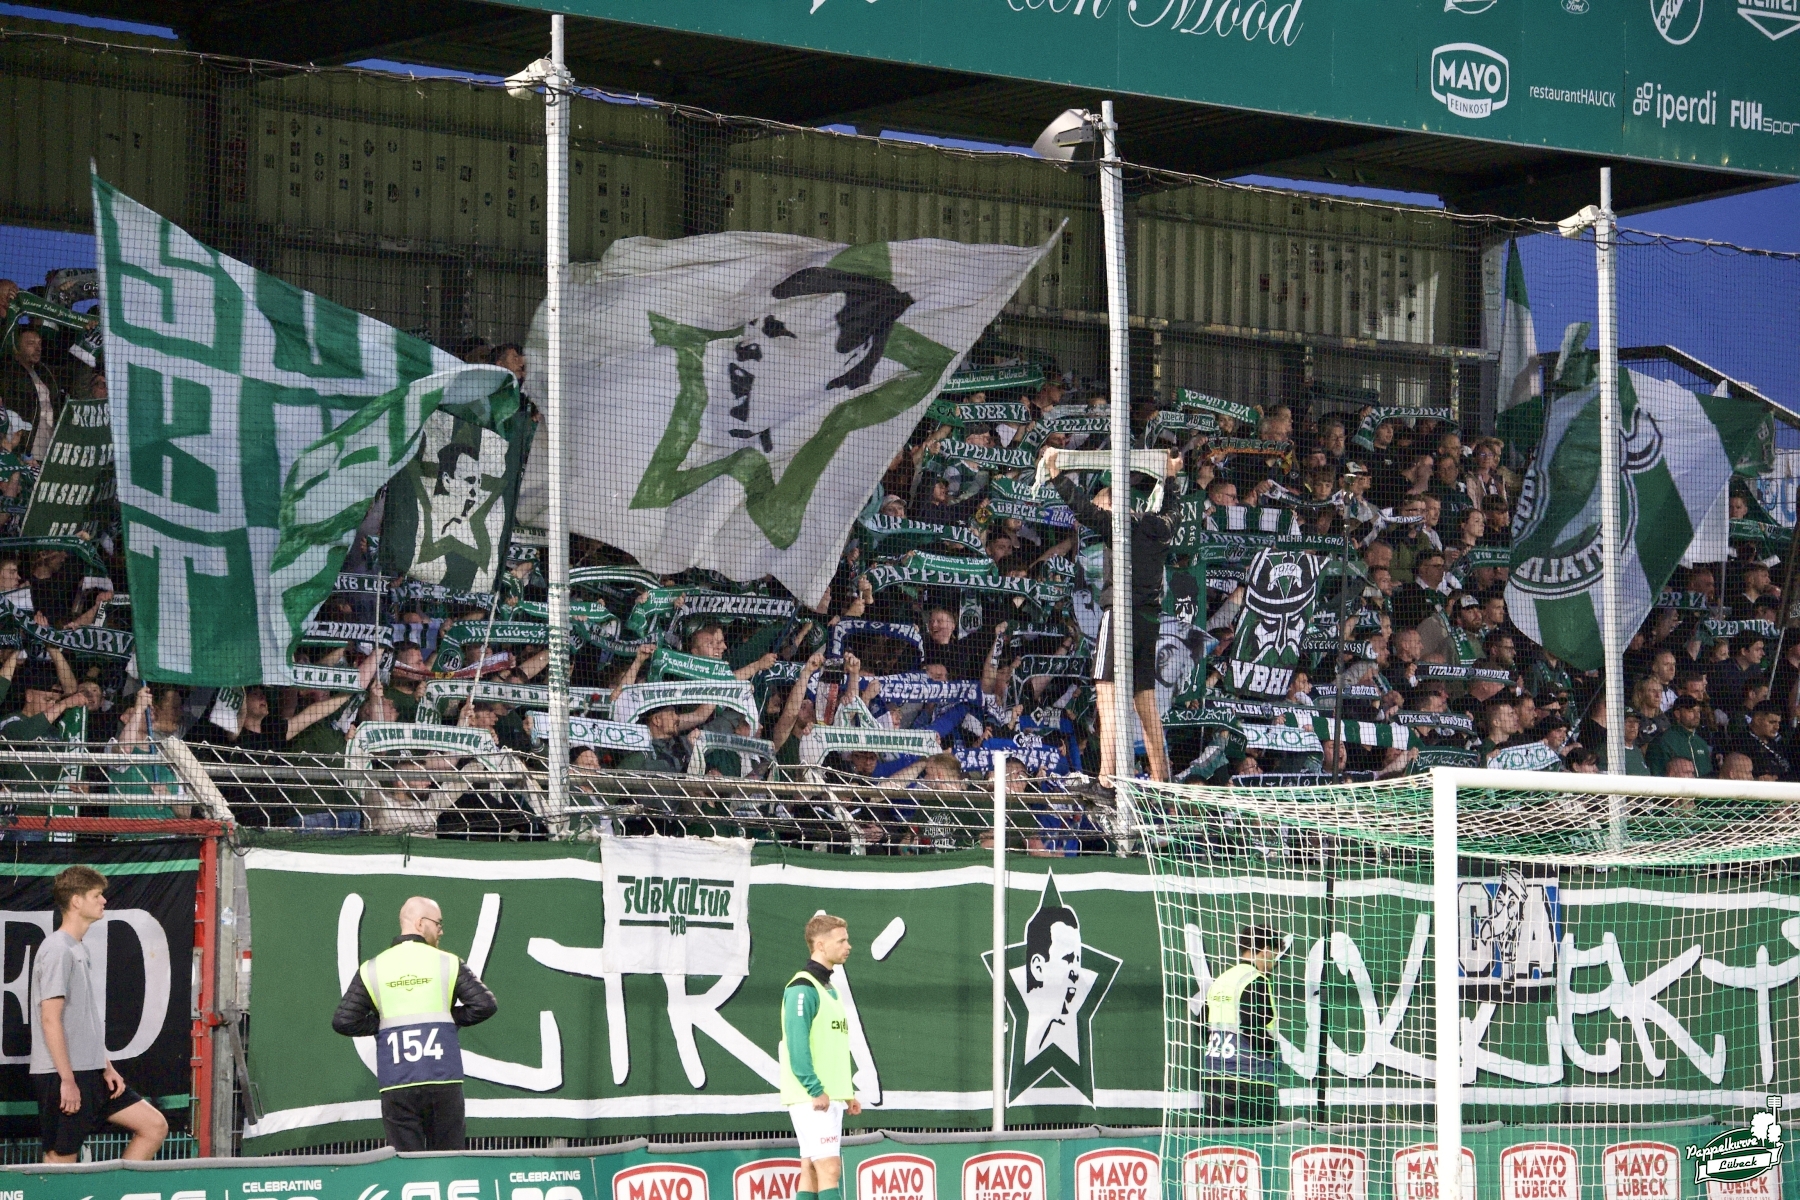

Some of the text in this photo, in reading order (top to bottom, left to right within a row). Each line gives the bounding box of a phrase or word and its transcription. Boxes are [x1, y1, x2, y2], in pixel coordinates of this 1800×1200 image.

[1439, 58, 1502, 94] MAYO
[1450, 99, 1489, 115] FEINKOST
[1656, 84, 1717, 127] iperdi
[1277, 534, 1303, 544] MEHR
[1306, 536, 1323, 545] ALS
[1272, 564, 1298, 576] 1919
[1428, 665, 1467, 677] VITALIEN
[624, 876, 731, 917] SUBKULTUR
[669, 915, 686, 937] VfB
[390, 978, 429, 989] GRIEGER
[387, 1028, 444, 1064] 154
[509, 1170, 594, 1183] CELEBRATING
[1090, 1162, 1148, 1187] MAYO
[1195, 1160, 1248, 1184] MAYO
[1303, 1158, 1354, 1182] MAYO
[1514, 1155, 1567, 1178] MAYO
[1615, 1154, 1668, 1177] MAYO
[242, 1180, 322, 1192] CELEBRATING
[629, 1177, 692, 1200] MAYO
[872, 1168, 923, 1194] MAYO
[976, 1165, 1033, 1190] MAYO
[1514, 1180, 1568, 1198] LÜBECK
[1616, 1178, 1668, 1197] LÜBECK
